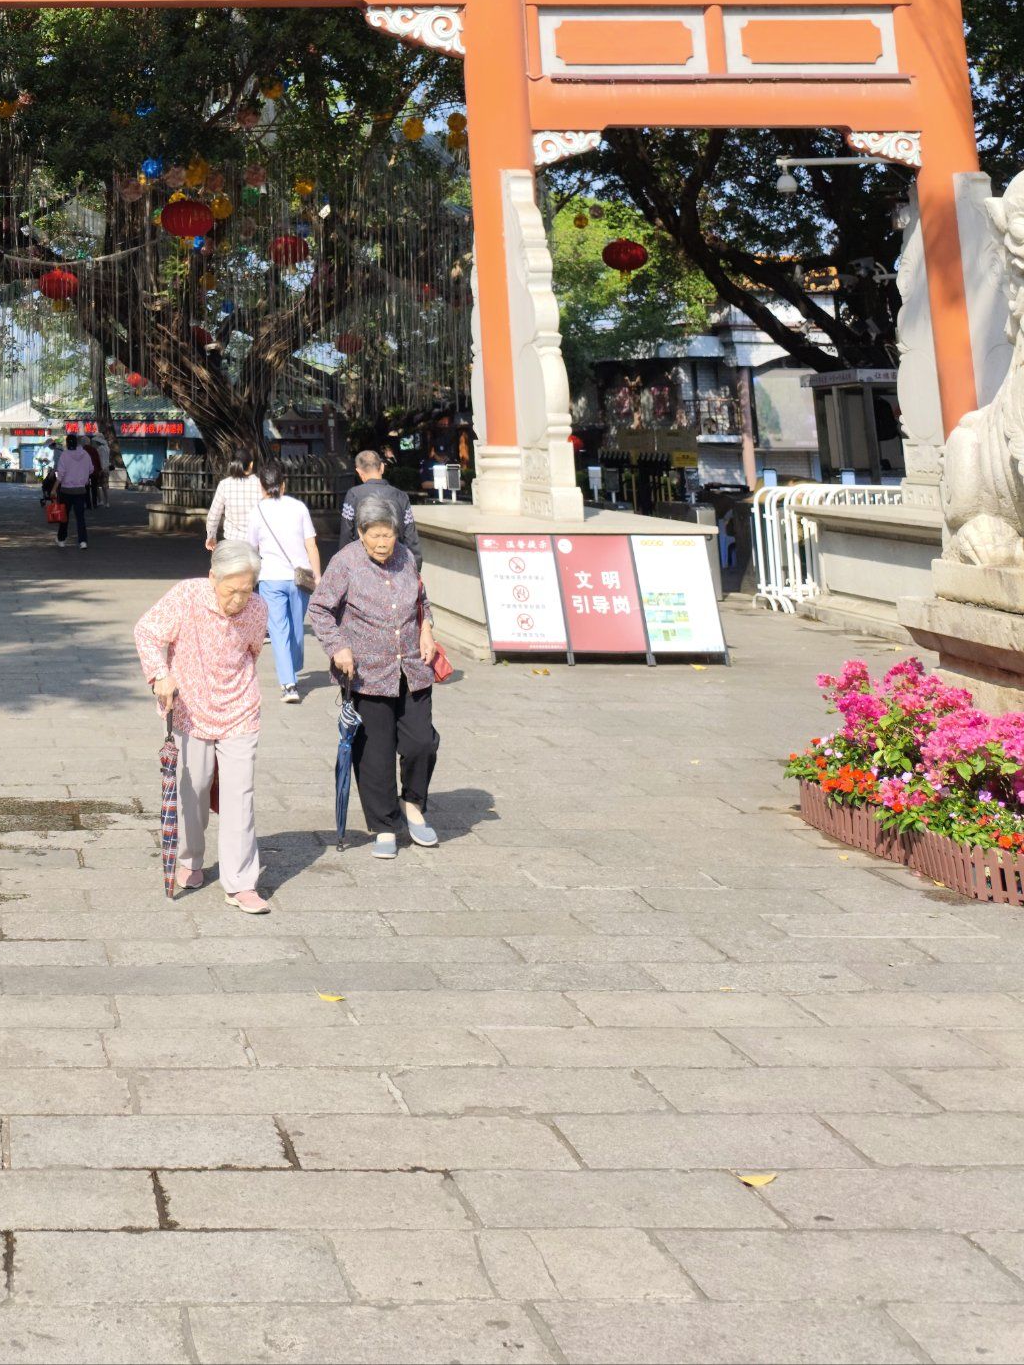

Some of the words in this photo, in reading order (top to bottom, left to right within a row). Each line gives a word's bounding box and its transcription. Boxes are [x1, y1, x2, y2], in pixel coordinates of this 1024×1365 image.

[574, 570, 621, 590] 文明
[571, 595, 631, 615] 引导岗
